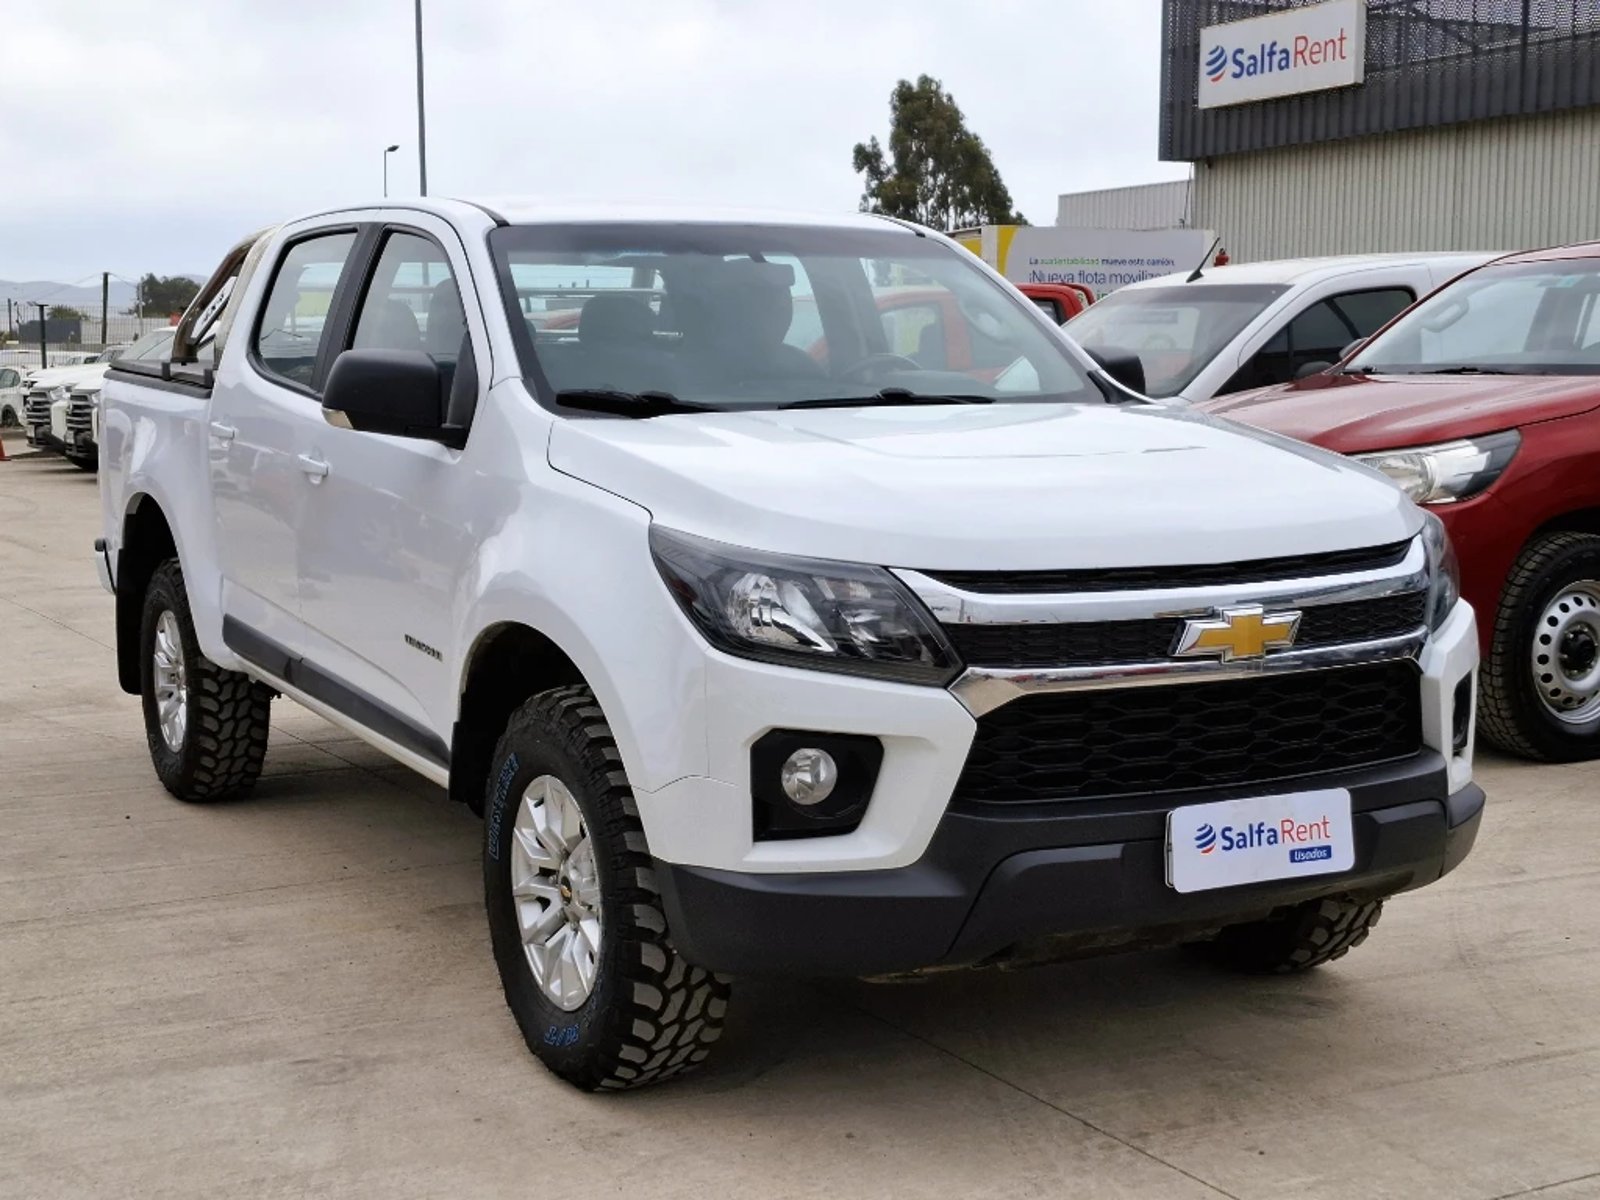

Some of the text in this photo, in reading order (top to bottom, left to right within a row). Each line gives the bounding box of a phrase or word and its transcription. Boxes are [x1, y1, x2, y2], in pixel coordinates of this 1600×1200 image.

[1029, 257, 1039, 265] La
[1101, 257, 1127, 266] mueve
[1128, 257, 1144, 266] este
[1078, 269, 1103, 285] flota
[1294, 848, 1328, 861] Usados
